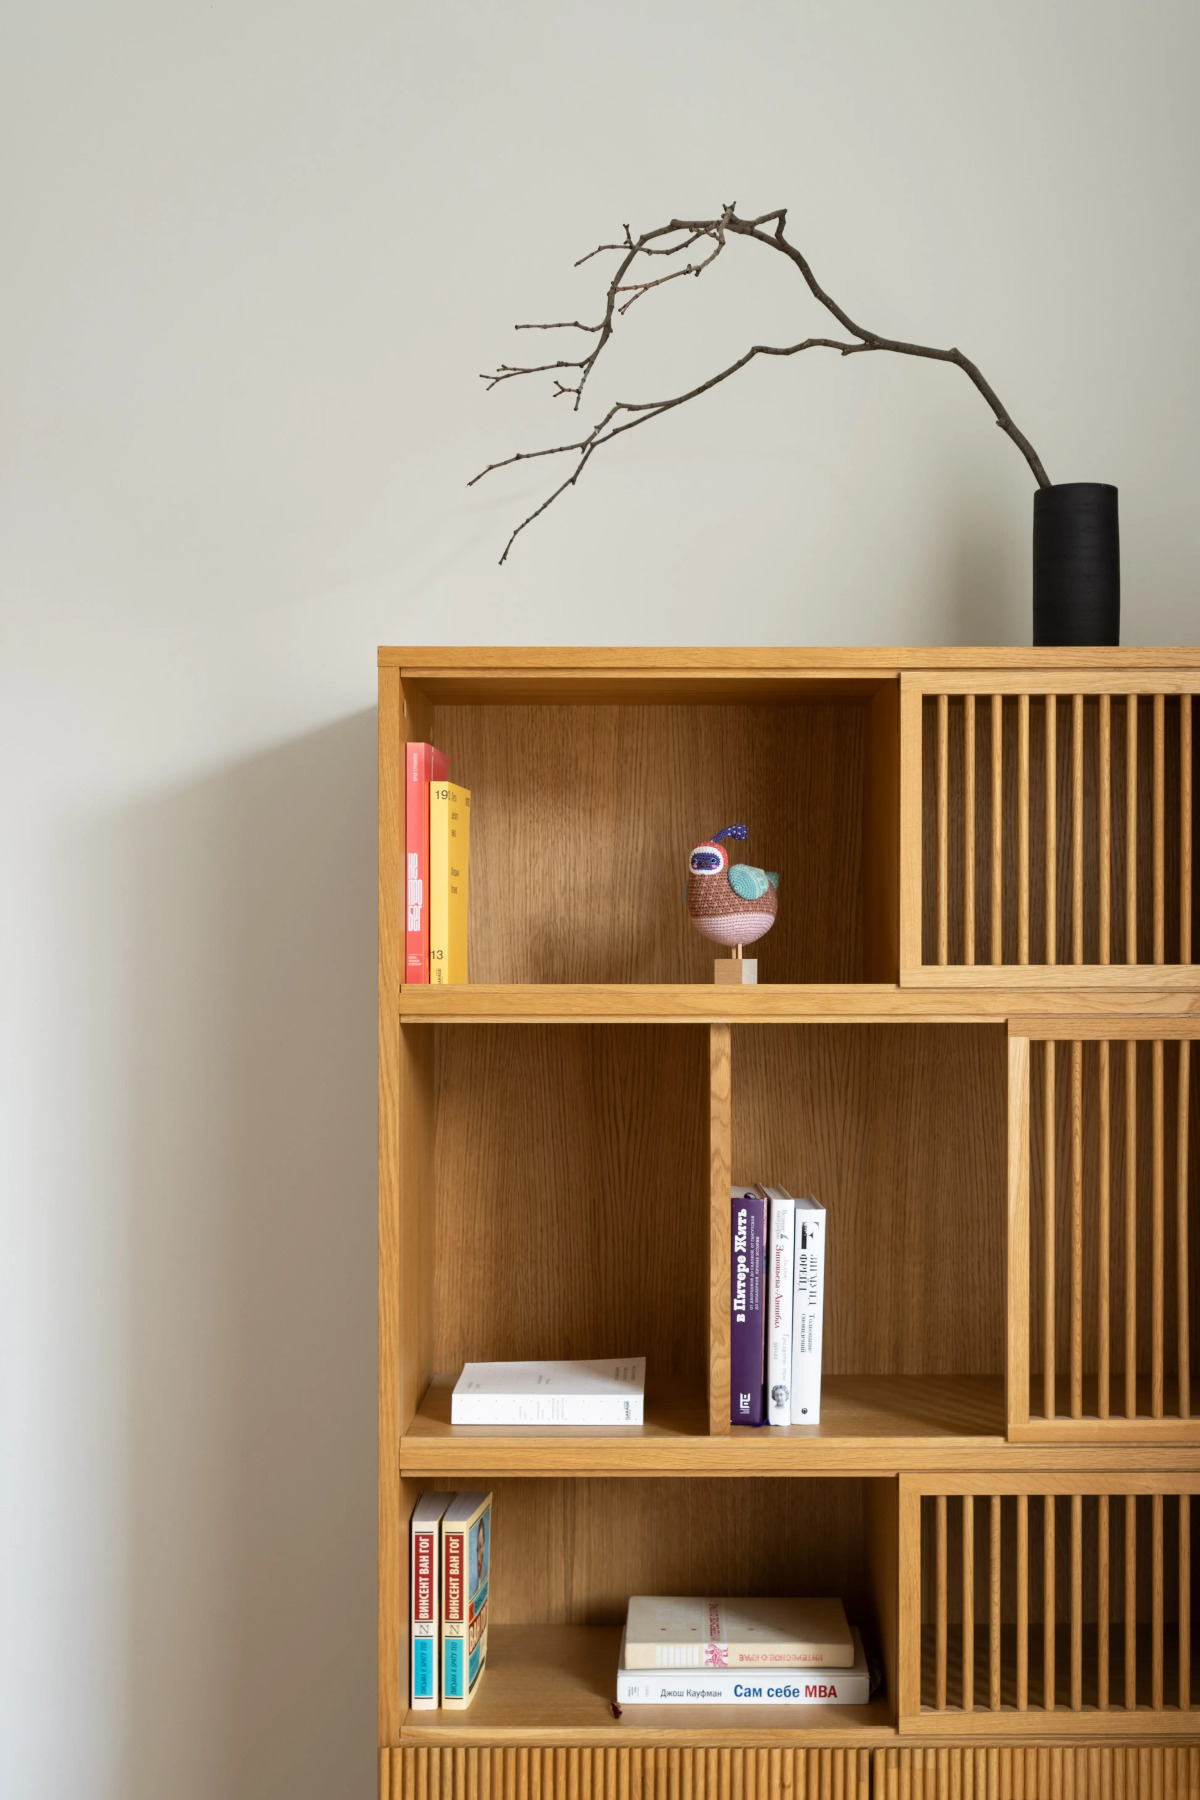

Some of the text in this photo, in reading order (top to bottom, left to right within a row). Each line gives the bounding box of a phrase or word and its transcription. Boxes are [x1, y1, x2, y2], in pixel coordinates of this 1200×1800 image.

[734, 1208, 748, 1253] Жить
[733, 1255, 750, 1311] Питере
[774, 1244, 784, 1329] Зиновьева-Аннибал
[798, 1253, 809, 1292] ФРЕЙД
[807, 1254, 818, 1306] ЗИГМУНД
[800, 1313, 808, 1353] сновидений
[808, 1313, 816, 1354] Толкование
[418, 1537, 430, 1619] ВИНСЕНТ ВАН ГОГ
[448, 1537, 460, 1619] ВИНСЕНТ ВАН ГОГ
[419, 1652, 428, 1668] БРАТУ
[449, 1652, 458, 1668] БРАТУ
[738, 1654, 760, 1662] КРАЕ
[660, 1688, 685, 1698] Джош
[686, 1688, 723, 1699] Кауфман
[734, 1684, 838, 1698] Сам себе MBA
